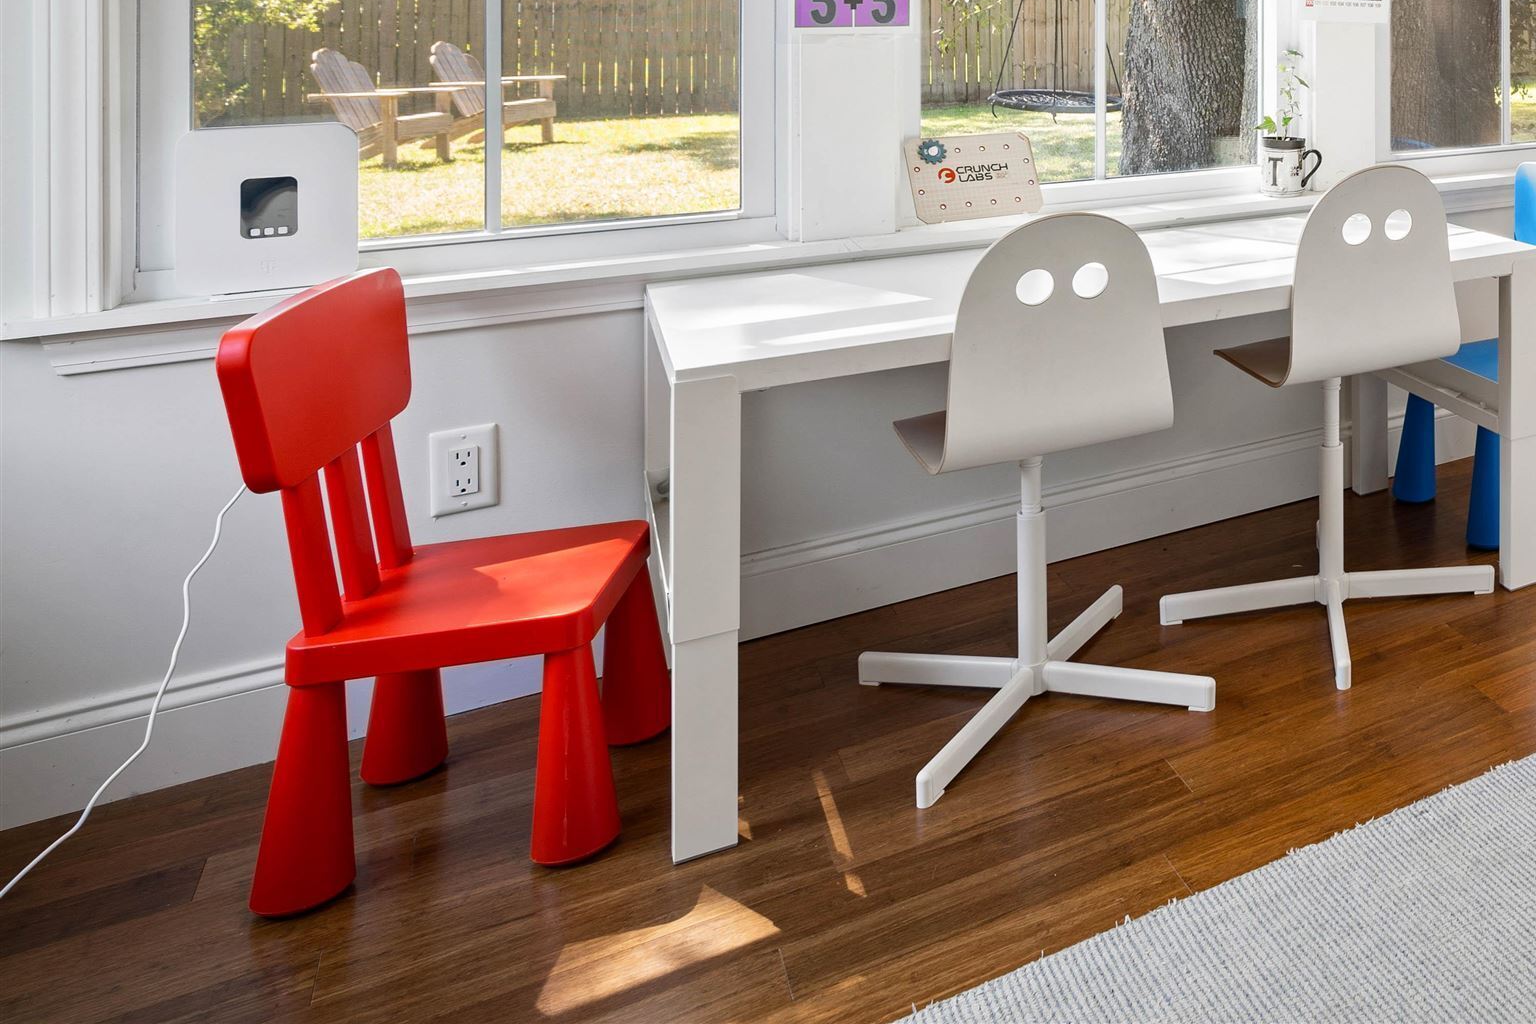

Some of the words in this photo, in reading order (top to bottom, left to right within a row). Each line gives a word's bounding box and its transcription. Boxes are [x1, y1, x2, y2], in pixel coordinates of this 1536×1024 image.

[956, 163, 1008, 174] CRUNCH
[1268, 157, 1283, 186] T
[959, 172, 993, 183] LABS
